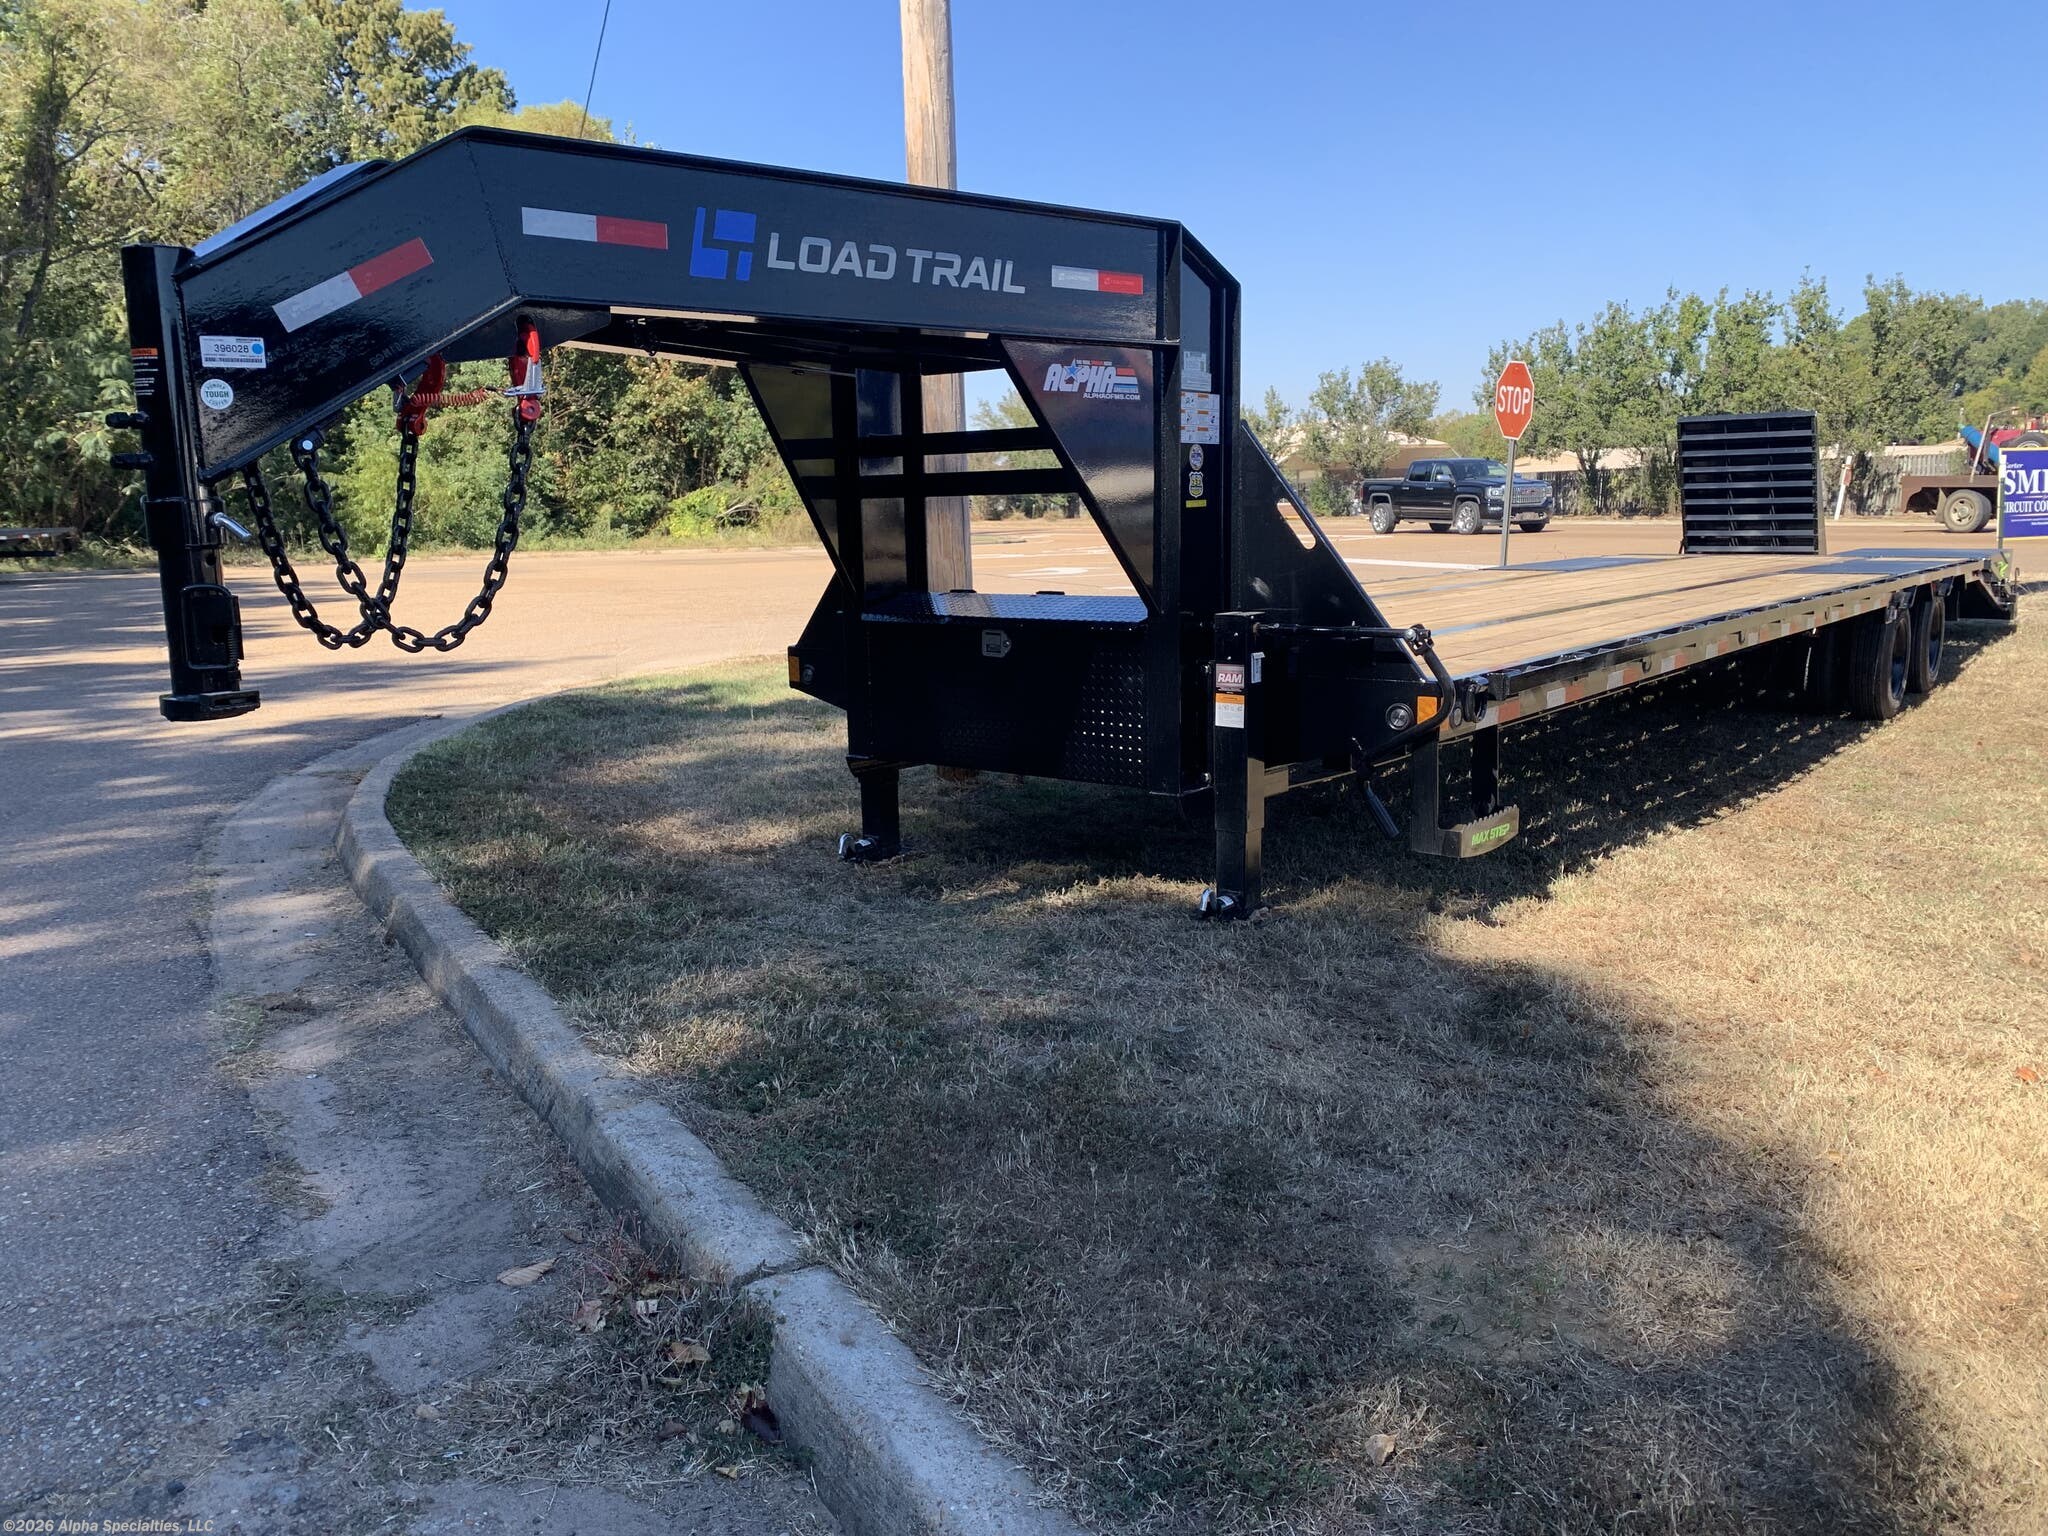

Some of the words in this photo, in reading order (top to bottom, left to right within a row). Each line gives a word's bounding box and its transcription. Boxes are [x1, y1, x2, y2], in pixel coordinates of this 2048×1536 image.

[767, 232, 897, 280] LOAD
[905, 248, 1026, 294] TRAIL
[213, 343, 249, 353] 396028
[1043, 362, 1116, 392] ALPHA
[205, 390, 229, 398] TOUGH
[1498, 385, 1531, 415] STOP
[2004, 501, 2033, 513] IRCUIT
[1217, 672, 1242, 684] RAM
[1472, 830, 1489, 845] MAX
[1490, 823, 1510, 839] STEP
